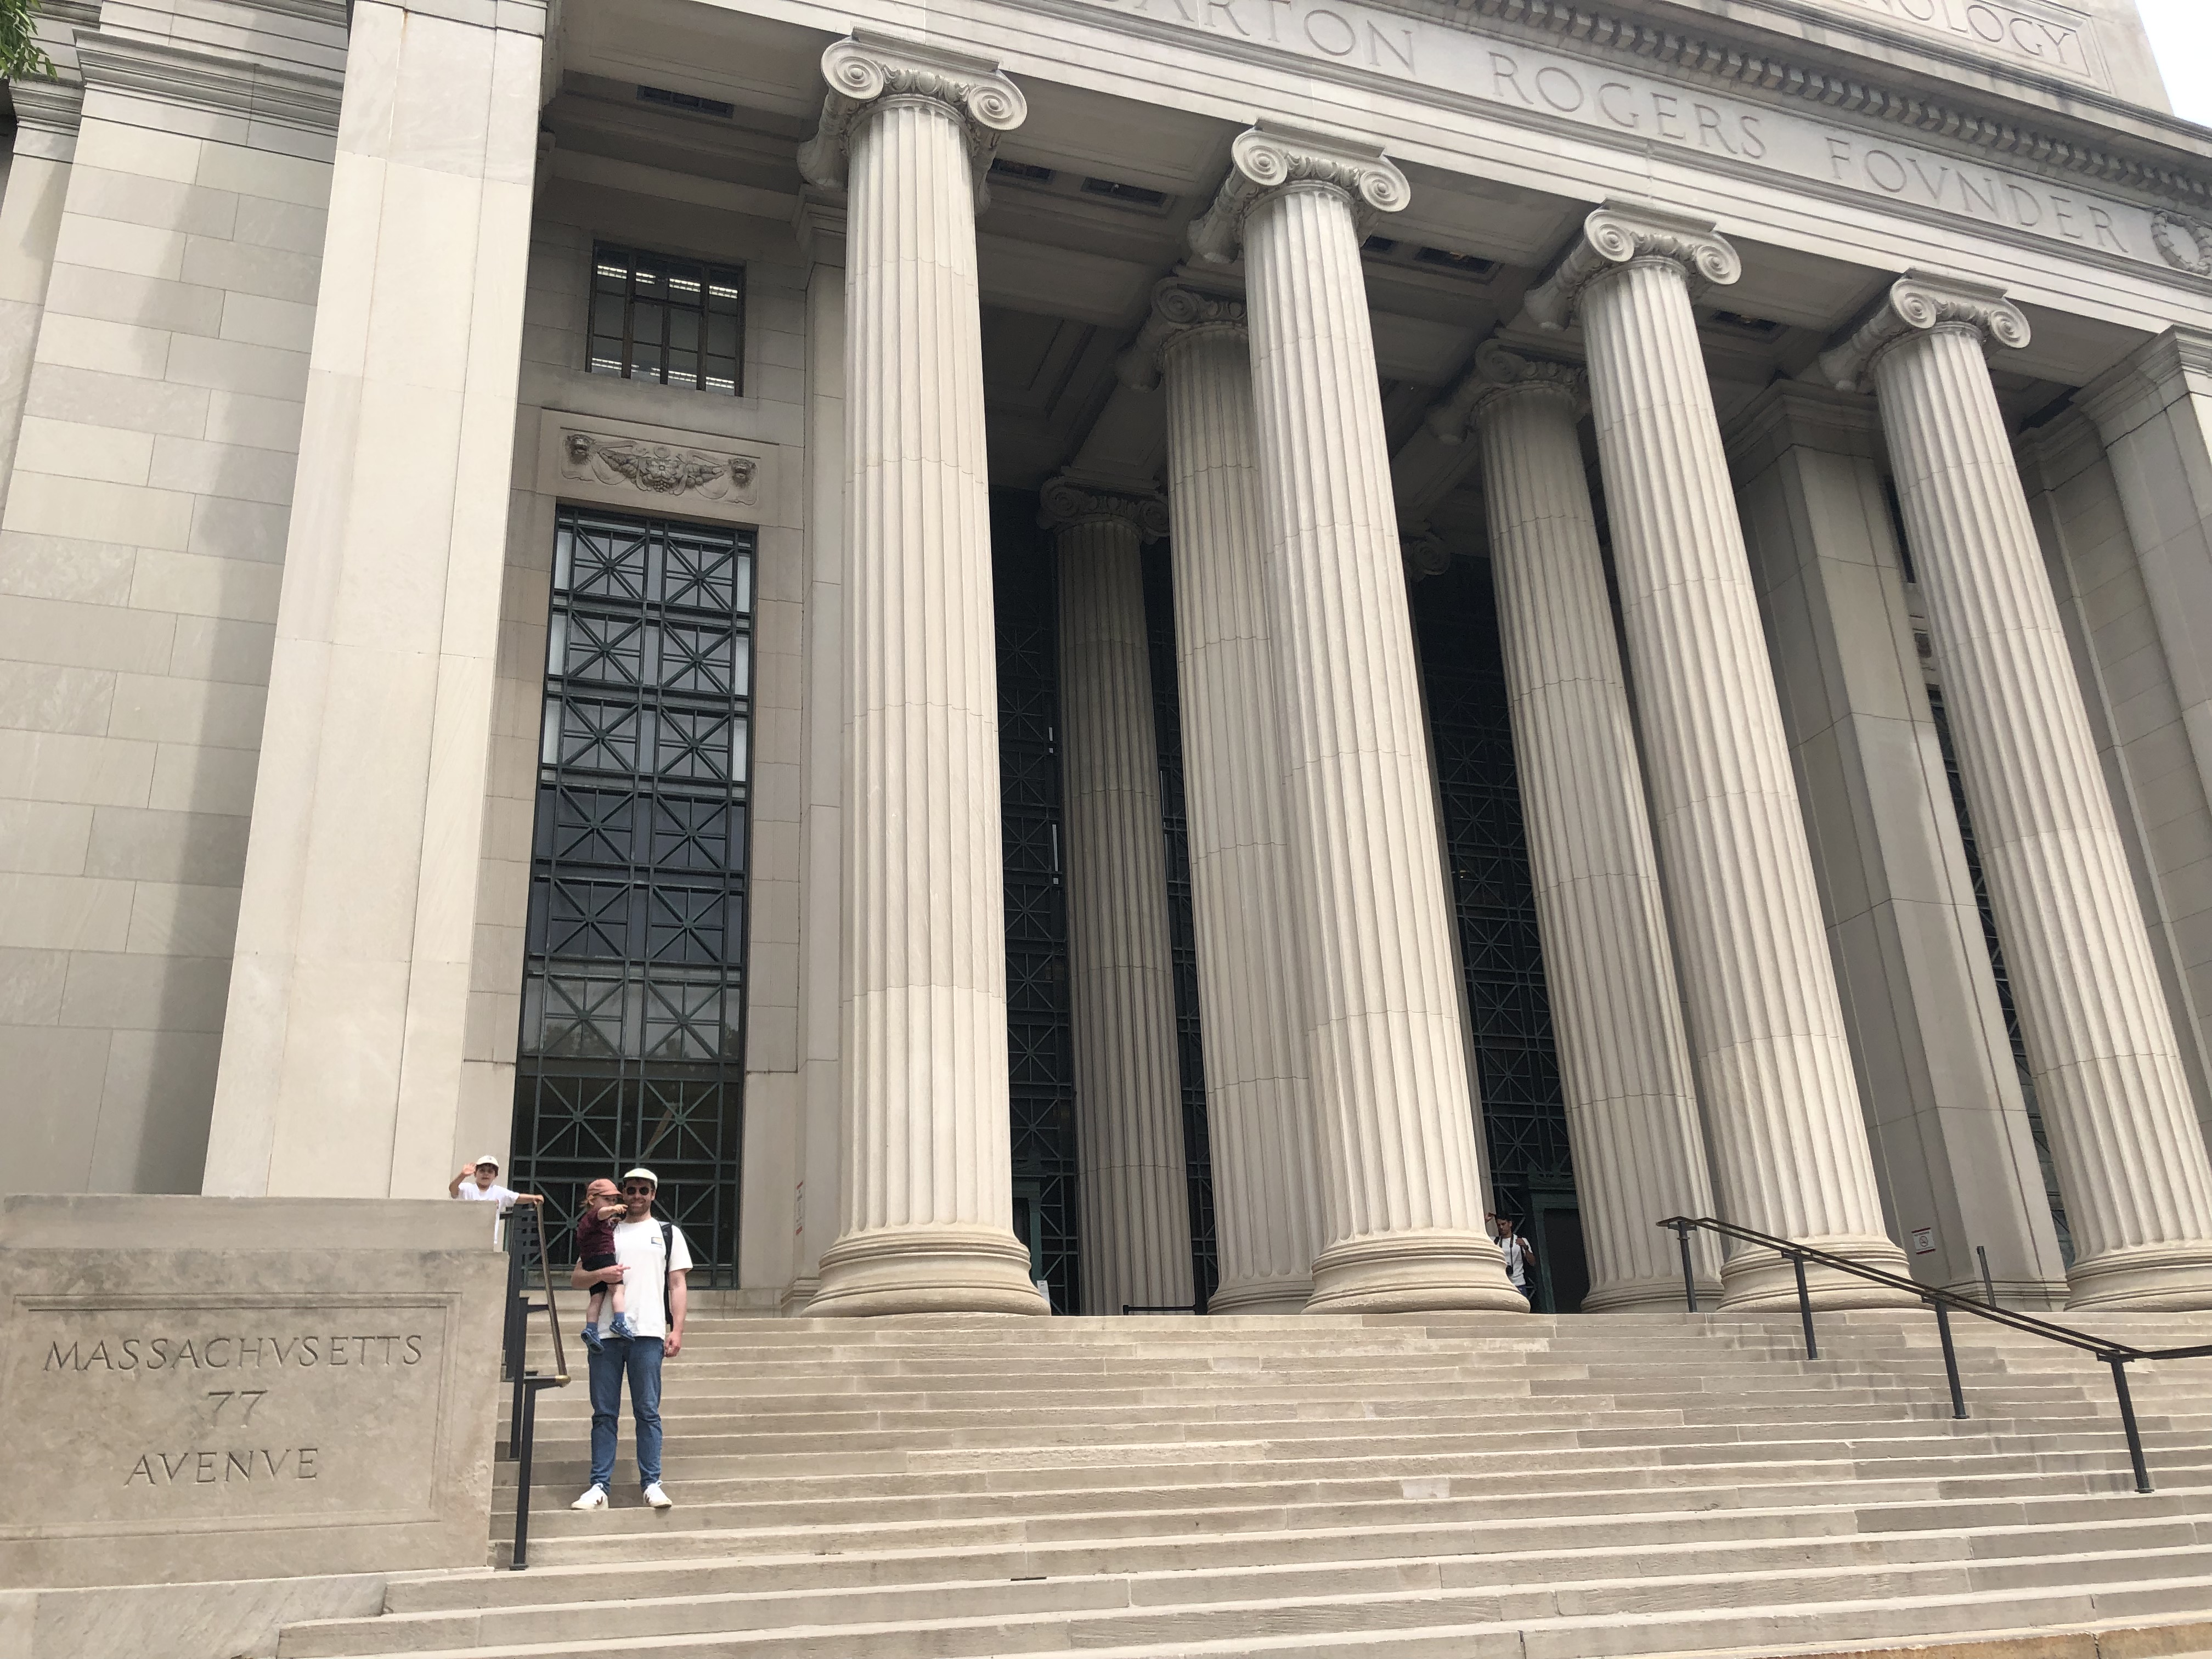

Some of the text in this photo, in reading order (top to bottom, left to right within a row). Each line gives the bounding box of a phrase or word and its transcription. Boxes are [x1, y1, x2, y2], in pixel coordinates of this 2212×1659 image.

[1488, 51, 1767, 159] ROGERS
[1824, 137, 2129, 253] FOVNDER
[43, 1335, 422, 1372] MASSACHVSETTS
[207, 1389, 268, 1427] 77
[123, 1448, 319, 1486] AVENVE
